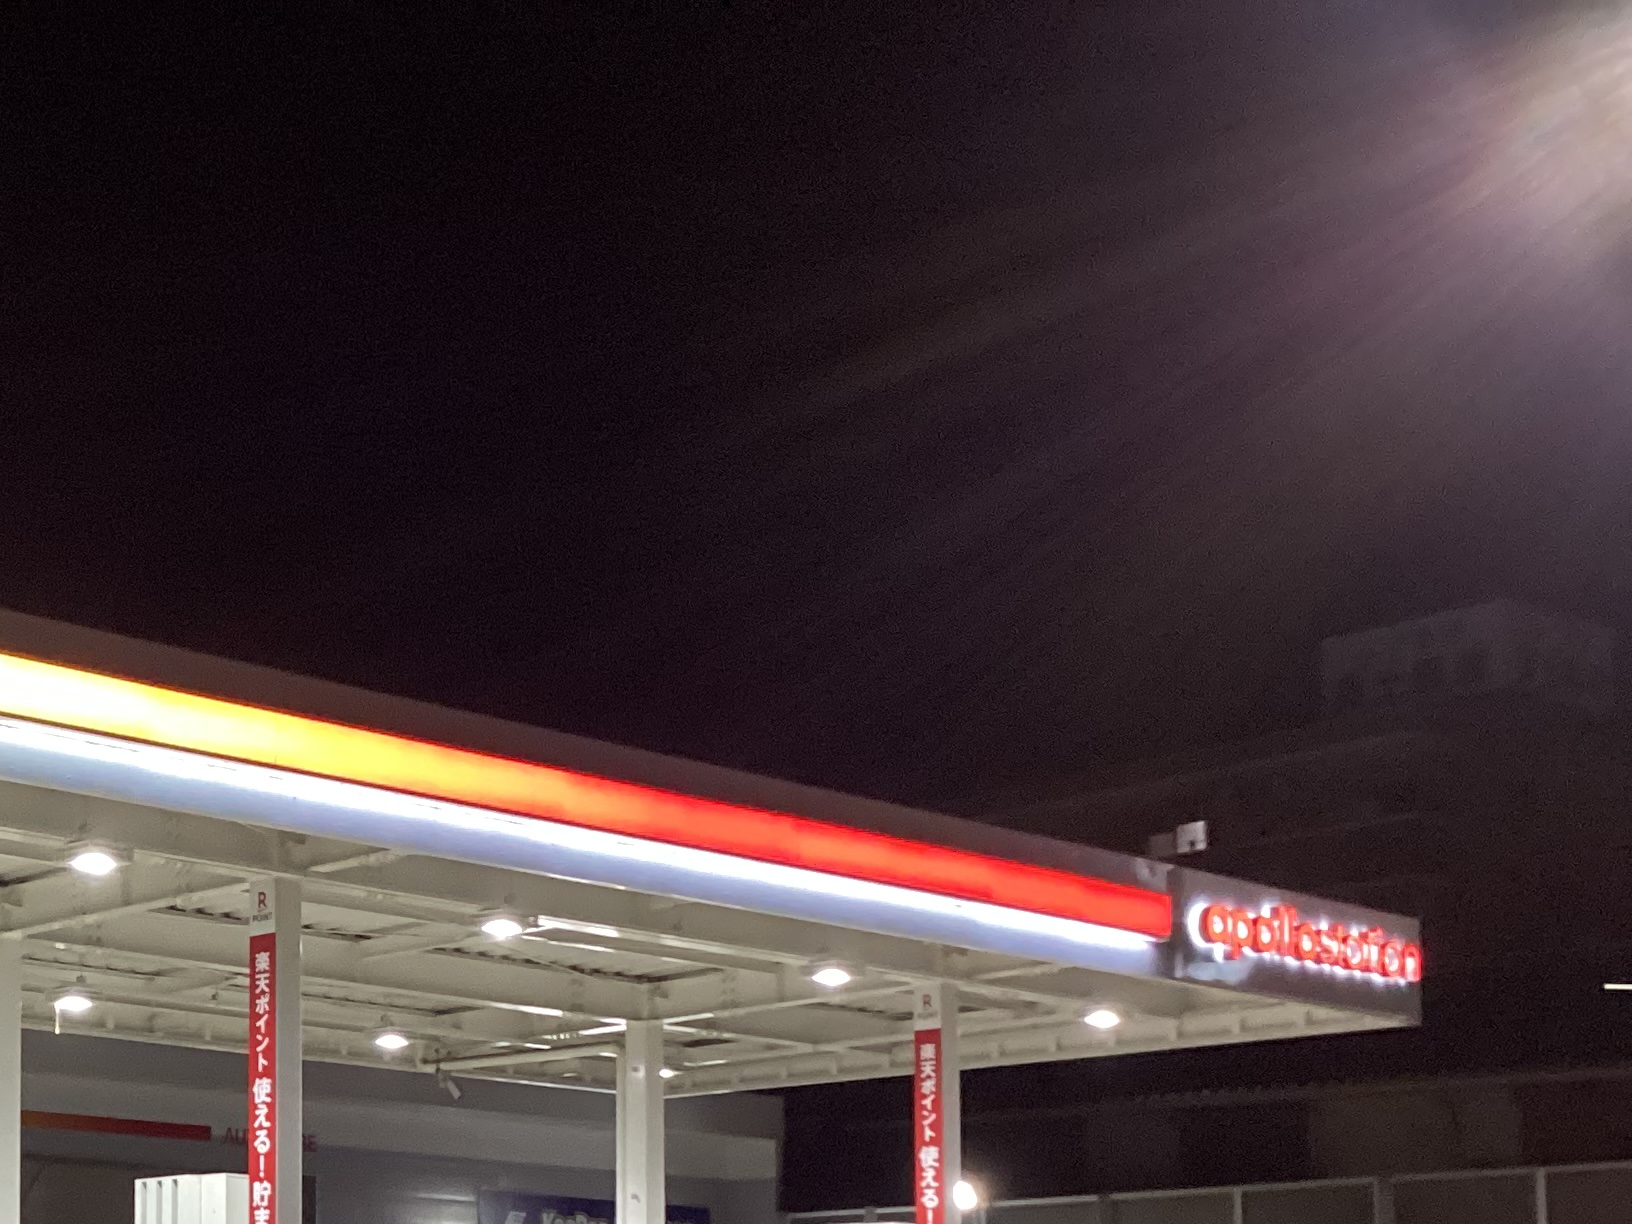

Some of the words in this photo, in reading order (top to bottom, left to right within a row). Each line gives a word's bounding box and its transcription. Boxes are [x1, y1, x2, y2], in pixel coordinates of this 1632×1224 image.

[258, 891, 267, 908] R
[1201, 904, 1422, 982] apollostation
[255, 951, 271, 1072] 楽天ポイント
[919, 1043, 937, 1142] 楽天ポイント
